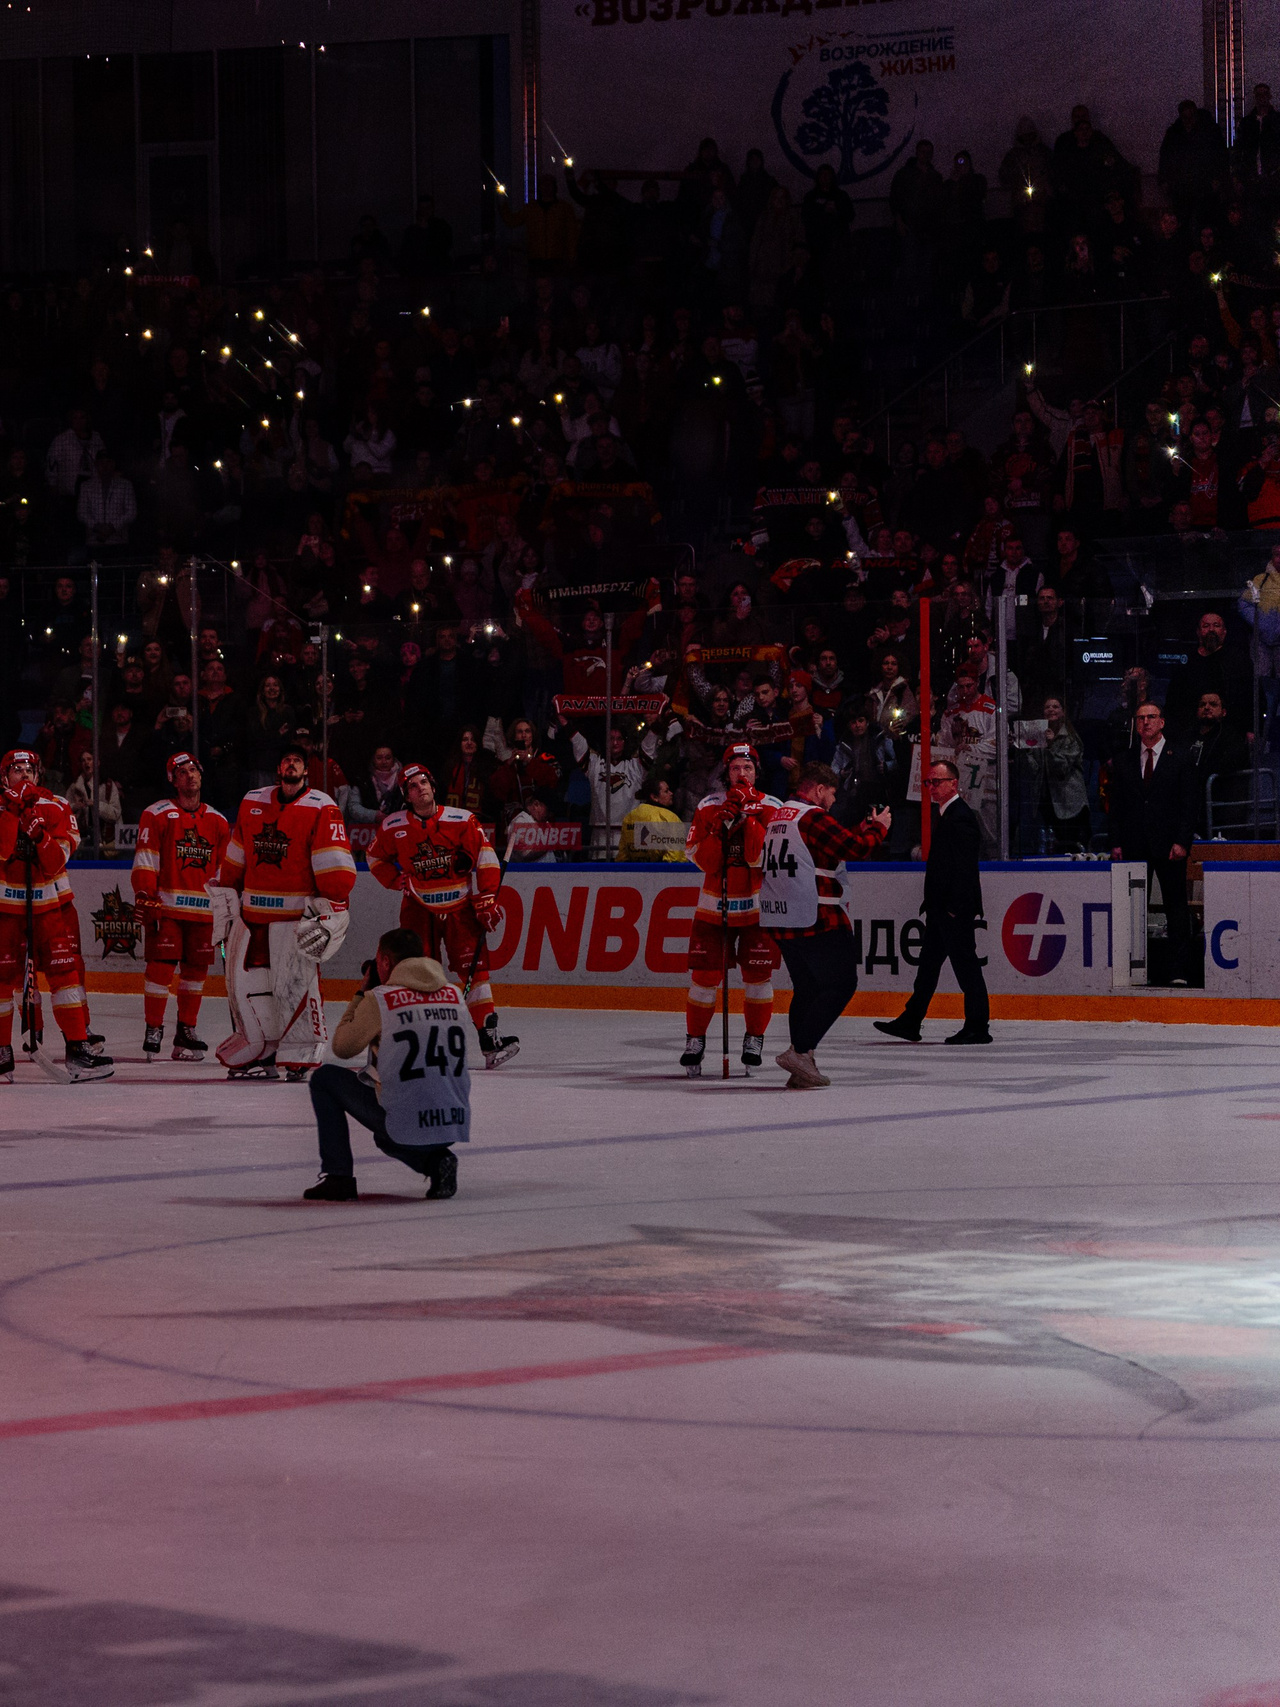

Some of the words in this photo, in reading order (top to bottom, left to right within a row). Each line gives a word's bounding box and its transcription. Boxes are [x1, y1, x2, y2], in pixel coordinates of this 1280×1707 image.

[820, 36, 954, 62] ВОЗРОЖДЕНИЕ
[880, 54, 955, 77] ЖИЗНИ
[702, 647, 752, 660] REDSTAR
[562, 699, 660, 711] AVANGARD
[330, 823, 346, 841] 29
[516, 827, 580, 846] FONBET
[651, 834, 687, 846] Ростеле
[176, 846, 212, 862] REDSTAR
[254, 841, 288, 857] REDSTAR
[413, 854, 452, 874] REDSTAR
[176, 896, 210, 908] SIBUR
[250, 896, 284, 907] SIBUR
[423, 891, 460, 903] SIBUR
[475, 897, 494, 909] CM
[93, 921, 143, 944] REDSTAR
[488, 886, 701, 973] ONBE
[310, 997, 322, 1037] CCM
[397, 1012, 413, 1025] TV
[425, 1008, 458, 1021] PHOTO
[393, 1025, 466, 1082] 249
